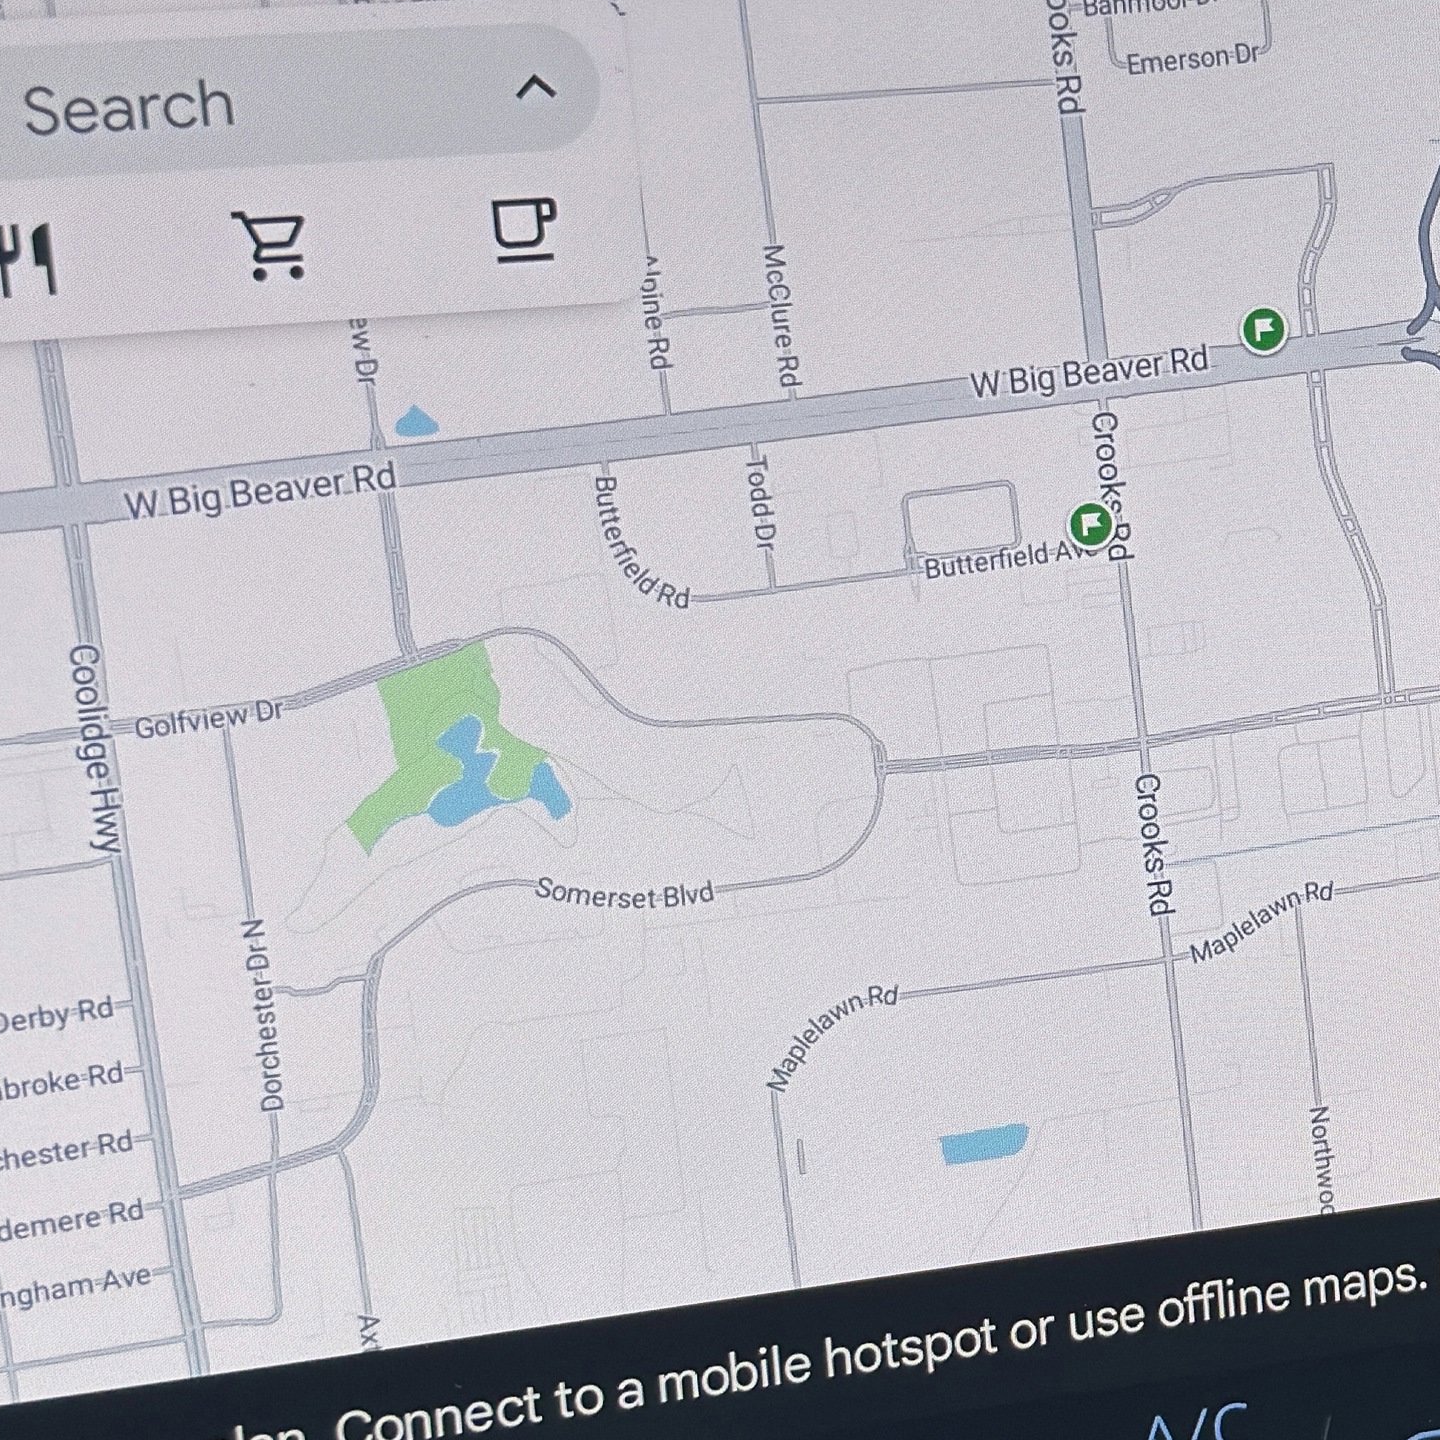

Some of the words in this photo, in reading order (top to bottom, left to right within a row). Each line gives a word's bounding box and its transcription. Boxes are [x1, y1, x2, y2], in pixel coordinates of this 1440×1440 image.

[1126, 46, 1231, 77] Emerson
[1234, 41, 1260, 64] Dr
[24, 78, 235, 136] Search
[1056, 74, 1086, 116] Rd
[763, 244, 792, 351] McClure
[776, 355, 801, 388] Rd
[969, 373, 1001, 398] W
[1008, 366, 1058, 399] Big
[1063, 355, 1164, 388] Beaver
[1170, 346, 1209, 374] Rd
[124, 490, 160, 520] W
[168, 485, 222, 518] Big
[230, 471, 346, 508] Beaver
[354, 462, 396, 491] Rd
[594, 475, 658, 596] Butterfield
[655, 582, 690, 611] Rd
[135, 705, 250, 739] Golfview
[255, 698, 284, 722] Dr
[69, 645, 111, 780] Coolidge
[90, 790, 122, 854] Hwy
[1135, 773, 1165, 873] Crooks
[535, 876, 656, 910] Somerset
[662, 880, 714, 905] Blvd
[1147, 878, 1176, 917] Rd
[241, 919, 265, 938] N
[1189, 890, 1302, 963] Maplelawn
[1305, 881, 1333, 902] Rd
[245, 940, 269, 972] Dr
[79, 997, 114, 1020] Rd
[248, 979, 286, 1112] Dorchester
[767, 994, 863, 1093] Maplelawn
[867, 984, 900, 1006] Rd
[87, 1061, 124, 1087] Rd
[96, 1130, 134, 1155] Rd
[107, 1198, 144, 1224] Rd
[101, 1266, 152, 1293] Ave
[554, 1380, 605, 1418] to
[616, 1379, 646, 1410] a
[658, 1349, 812, 1403] mobile
[823, 1317, 999, 1379] hotspot
[1010, 1314, 1055, 1348] or
[1069, 1304, 1145, 1341] use
[1158, 1279, 1291, 1328] offline
[1302, 1260, 1429, 1311] maps.
